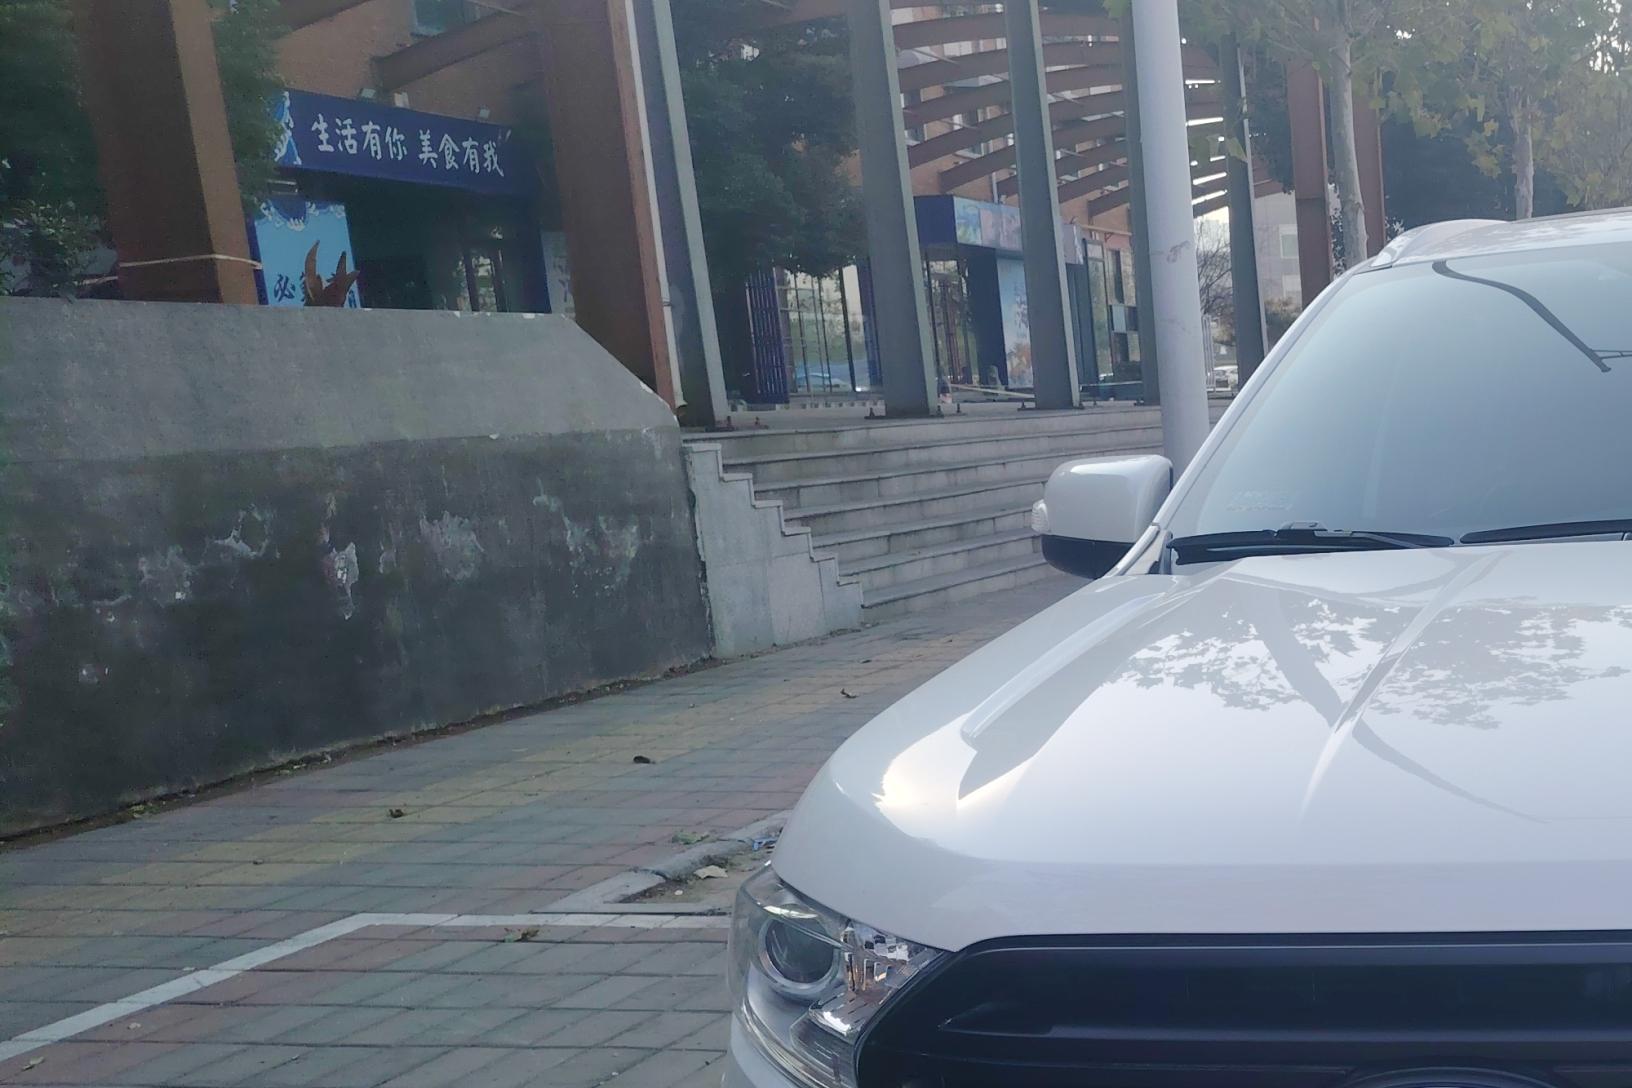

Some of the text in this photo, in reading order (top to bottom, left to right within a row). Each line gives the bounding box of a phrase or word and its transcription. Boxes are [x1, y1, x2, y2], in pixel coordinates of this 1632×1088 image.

[311, 113, 504, 177] 生活有你 美食有我
